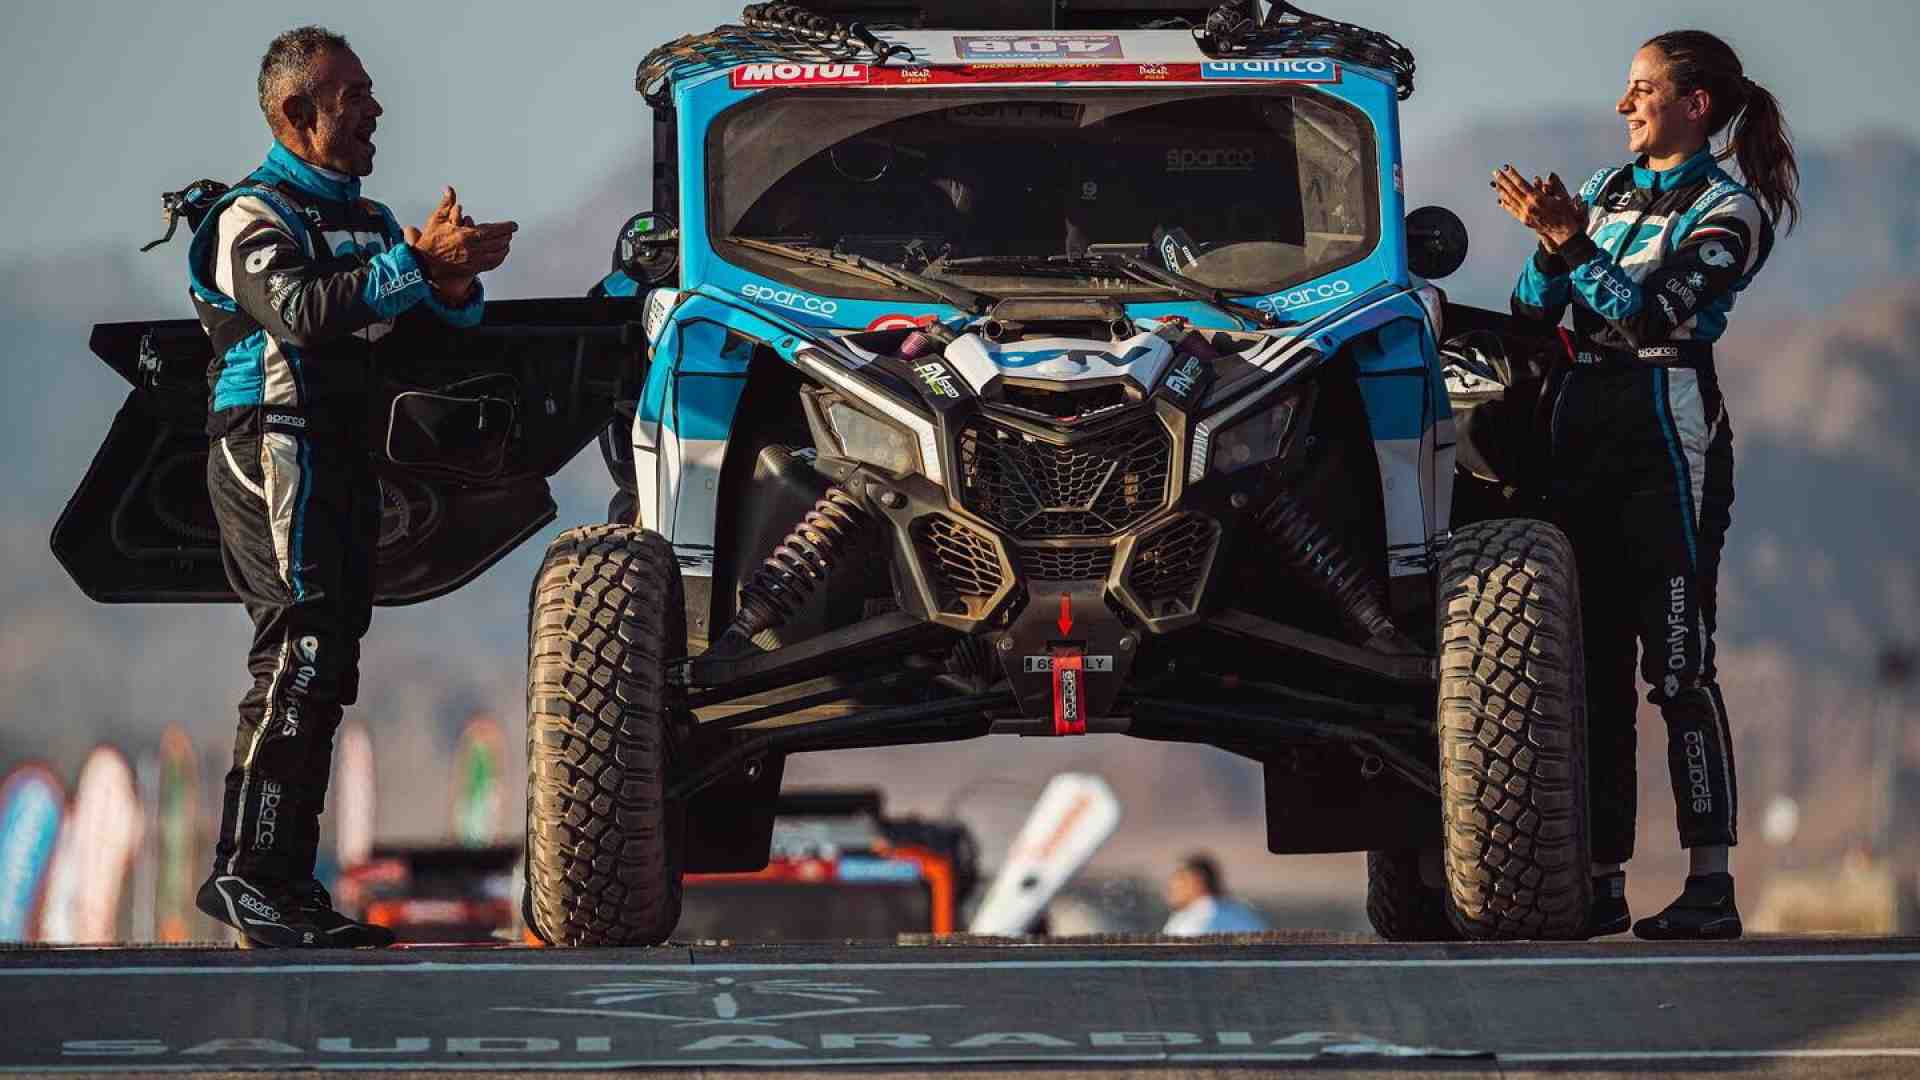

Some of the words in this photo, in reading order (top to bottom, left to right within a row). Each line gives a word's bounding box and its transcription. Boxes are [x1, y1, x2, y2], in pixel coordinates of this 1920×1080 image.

[742, 64, 861, 80] MOTUL
[1209, 61, 1328, 73] aramco
[379, 268, 424, 298] sparco
[1256, 279, 1351, 313] sparco
[741, 283, 838, 316] sparco
[265, 412, 305, 427] sparco
[1667, 575, 1689, 670] OnlyFans
[1684, 731, 1711, 814] sparco
[238, 893, 281, 921] sparco
[62, 1037, 611, 1056] SAUDI
[677, 1030, 1388, 1050] ARABIA
